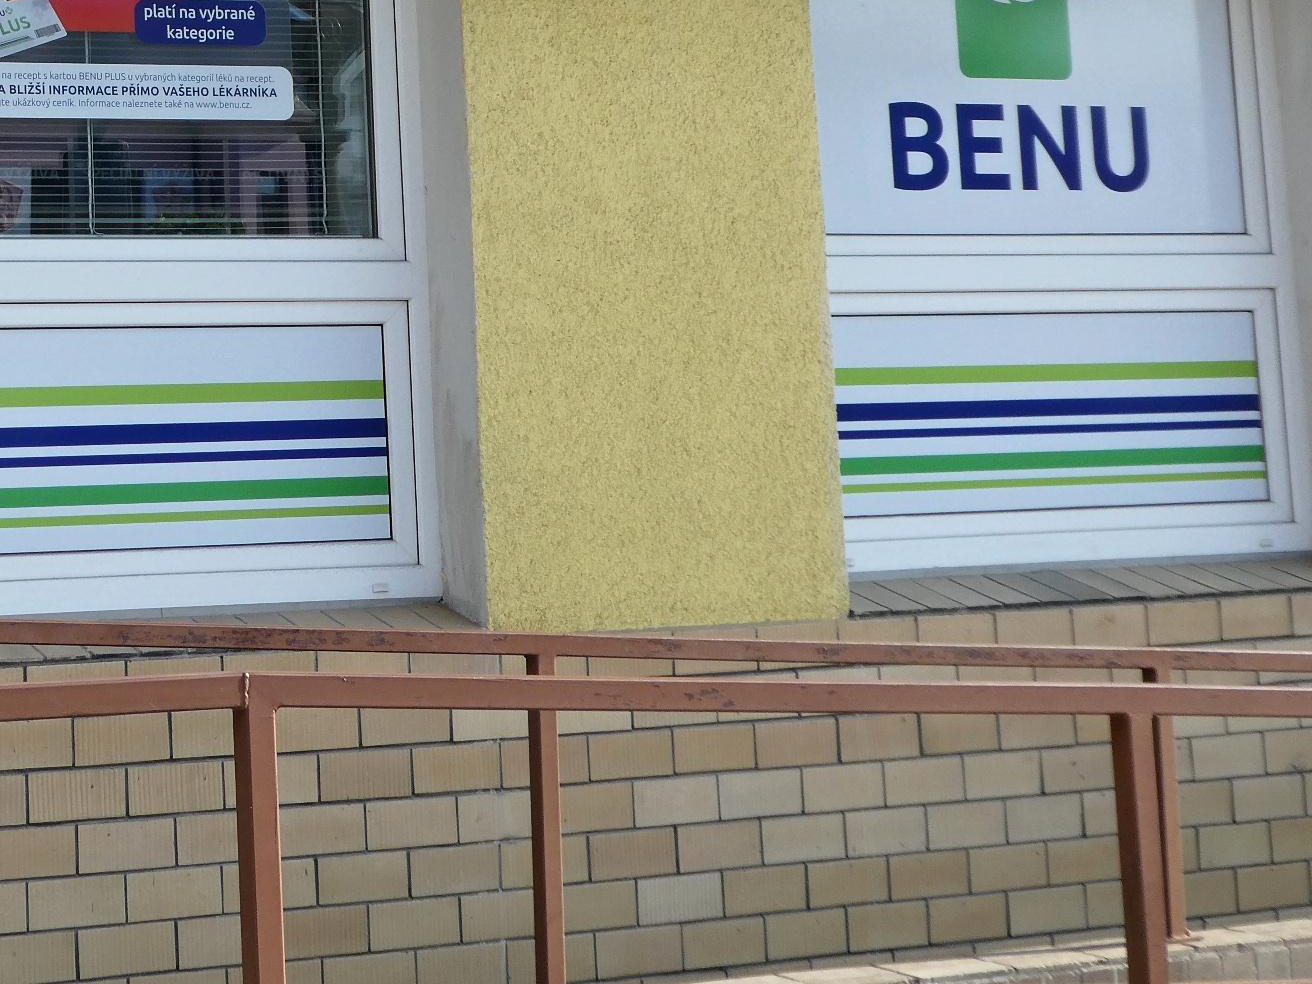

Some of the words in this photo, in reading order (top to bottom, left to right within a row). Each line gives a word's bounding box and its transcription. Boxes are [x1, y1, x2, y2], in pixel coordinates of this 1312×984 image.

[144, 3, 175, 20] platí
[179, 8, 195, 18] na
[199, 5, 254, 22] vybrané
[167, 25, 234, 44] kategorie
[14, 71, 41, 83] recept
[49, 71, 76, 83] kartou
[78, 71, 102, 80] BENU
[104, 72, 126, 82] PLUS
[134, 72, 176, 84] vybraných
[215, 73, 232, 85] léků
[234, 75, 244, 85] na
[246, 74, 275, 86] recept.
[9, 82, 44, 94] BLIŽŠÍ
[48, 84, 118, 96] INFORMACE
[121, 83, 159, 96] PŘÍMO
[162, 84, 208, 97] VAŠEHO
[212, 84, 276, 98] LÉKÁRNÍKA
[12, 96, 50, 108] ukázkový
[52, 98, 76, 107] ceník.
[78, 96, 120, 108] Informace
[122, 98, 162, 108] naleznete
[164, 98, 182, 108] také
[195, 99, 252, 111] www.benu.cz.
[888, 101, 1150, 193] BENU
